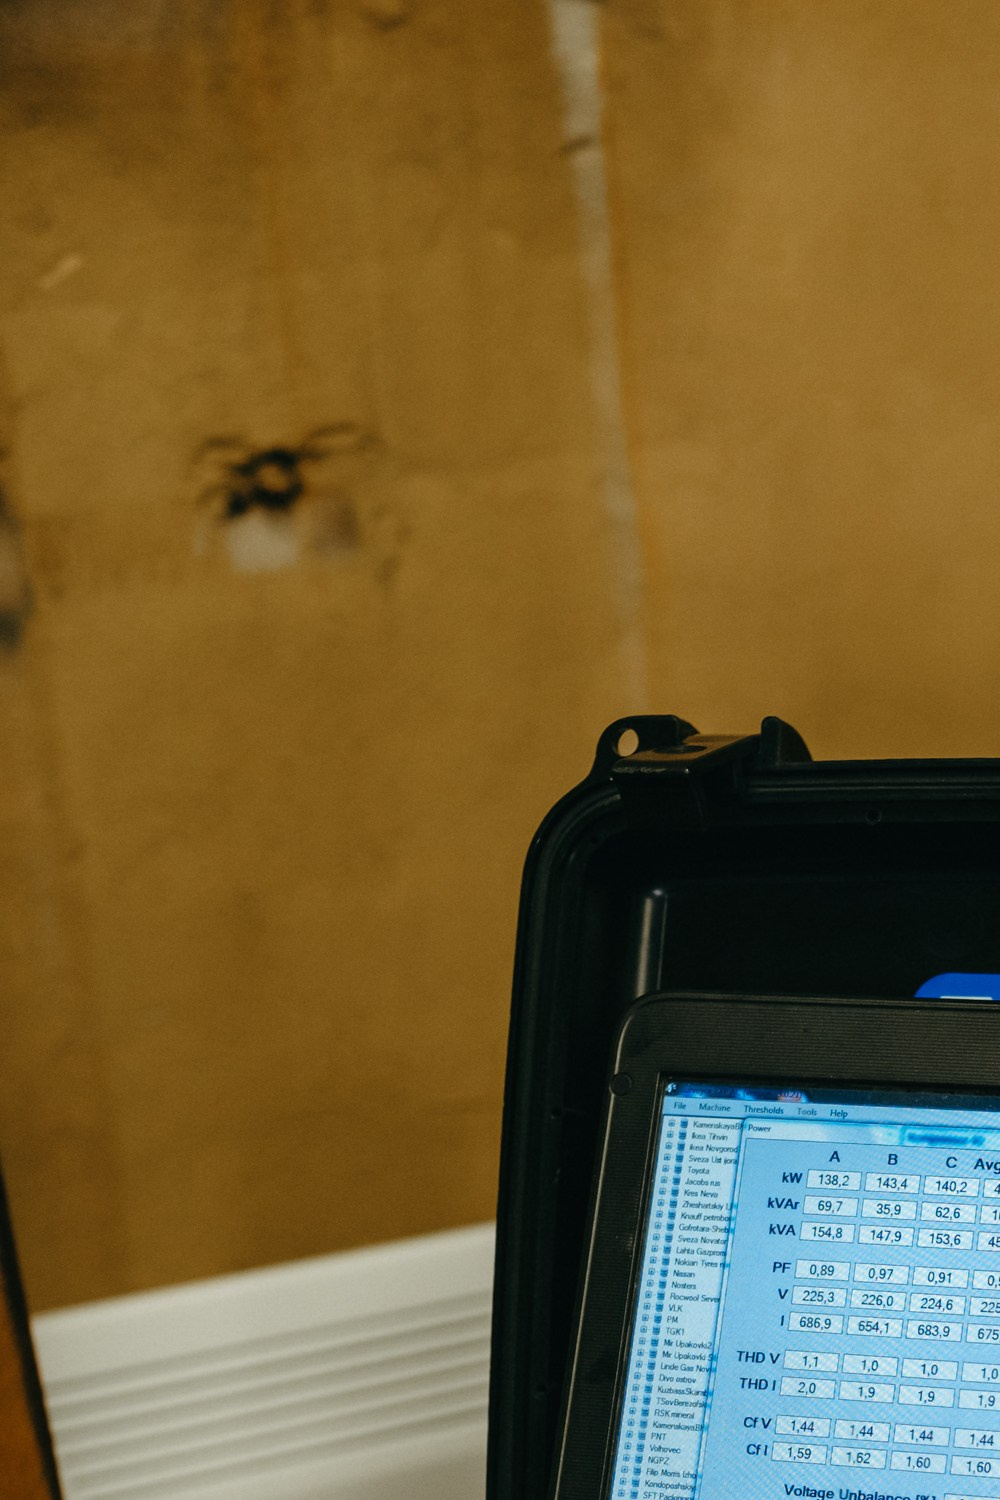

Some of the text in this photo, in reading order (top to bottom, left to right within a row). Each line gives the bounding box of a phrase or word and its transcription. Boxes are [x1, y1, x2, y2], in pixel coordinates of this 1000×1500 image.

[674, 1102, 848, 1119] File Machine Thresholds Tools Help
[748, 1124, 771, 1132] Power
[829, 1151, 840, 1162] A
[888, 1154, 897, 1165] B
[946, 1157, 957, 1168] C
[688, 1166, 710, 1175] Toyota
[685, 1178, 709, 1186] Jacobs
[782, 1172, 802, 1184] kW
[818, 1174, 850, 1187] 138,2
[877, 1177, 908, 1190] 143,4
[936, 1180, 968, 1193] 140,2
[767, 1198, 799, 1210] kVAr
[818, 1201, 843, 1213] 69,7
[876, 1204, 901, 1217] 35,9
[935, 1207, 961, 1220] 62,6
[769, 1224, 796, 1236] kVA
[811, 1227, 843, 1240] 154,8
[870, 1230, 902, 1243] 147,9
[929, 1234, 961, 1247] 153,6
[673, 1269, 695, 1277] Nissan
[773, 1262, 791, 1273] PF
[810, 1265, 835, 1278] 0,89
[868, 1268, 894, 1281] 0,97
[927, 1271, 952, 1284] 0,91
[672, 1281, 697, 1290] Nosters
[669, 1304, 683, 1312] VLK
[778, 1289, 788, 1300] V
[802, 1290, 835, 1304] 225,3
[861, 1294, 894, 1308] 226,0
[920, 1297, 953, 1311] 224,6
[666, 1327, 684, 1336] TGK1
[799, 1316, 832, 1330] 686,9
[858, 1320, 890, 1334] 654,1
[917, 1324, 950, 1338] 683,9
[736, 1351, 999, 1381] THD V 1,1 1,0 1,0 1,0
[739, 1377, 768, 1390] THD
[798, 1381, 816, 1395] 2,0
[858, 1386, 876, 1399] 1,9
[917, 1389, 935, 1403] 1,9
[978, 1393, 996, 1408] 1,9
[743, 1417, 994, 1447] Cf V 1,44 1,44 1,44 1,44
[648, 1457, 669, 1465] NGPZ
[746, 1444, 761, 1455] Cf
[787, 1447, 812, 1460] 1,59
[846, 1451, 871, 1465] 1,62
[906, 1455, 931, 1469] 1,60
[966, 1460, 992, 1474] 1,60
[784, 1484, 835, 1500] Voltage
